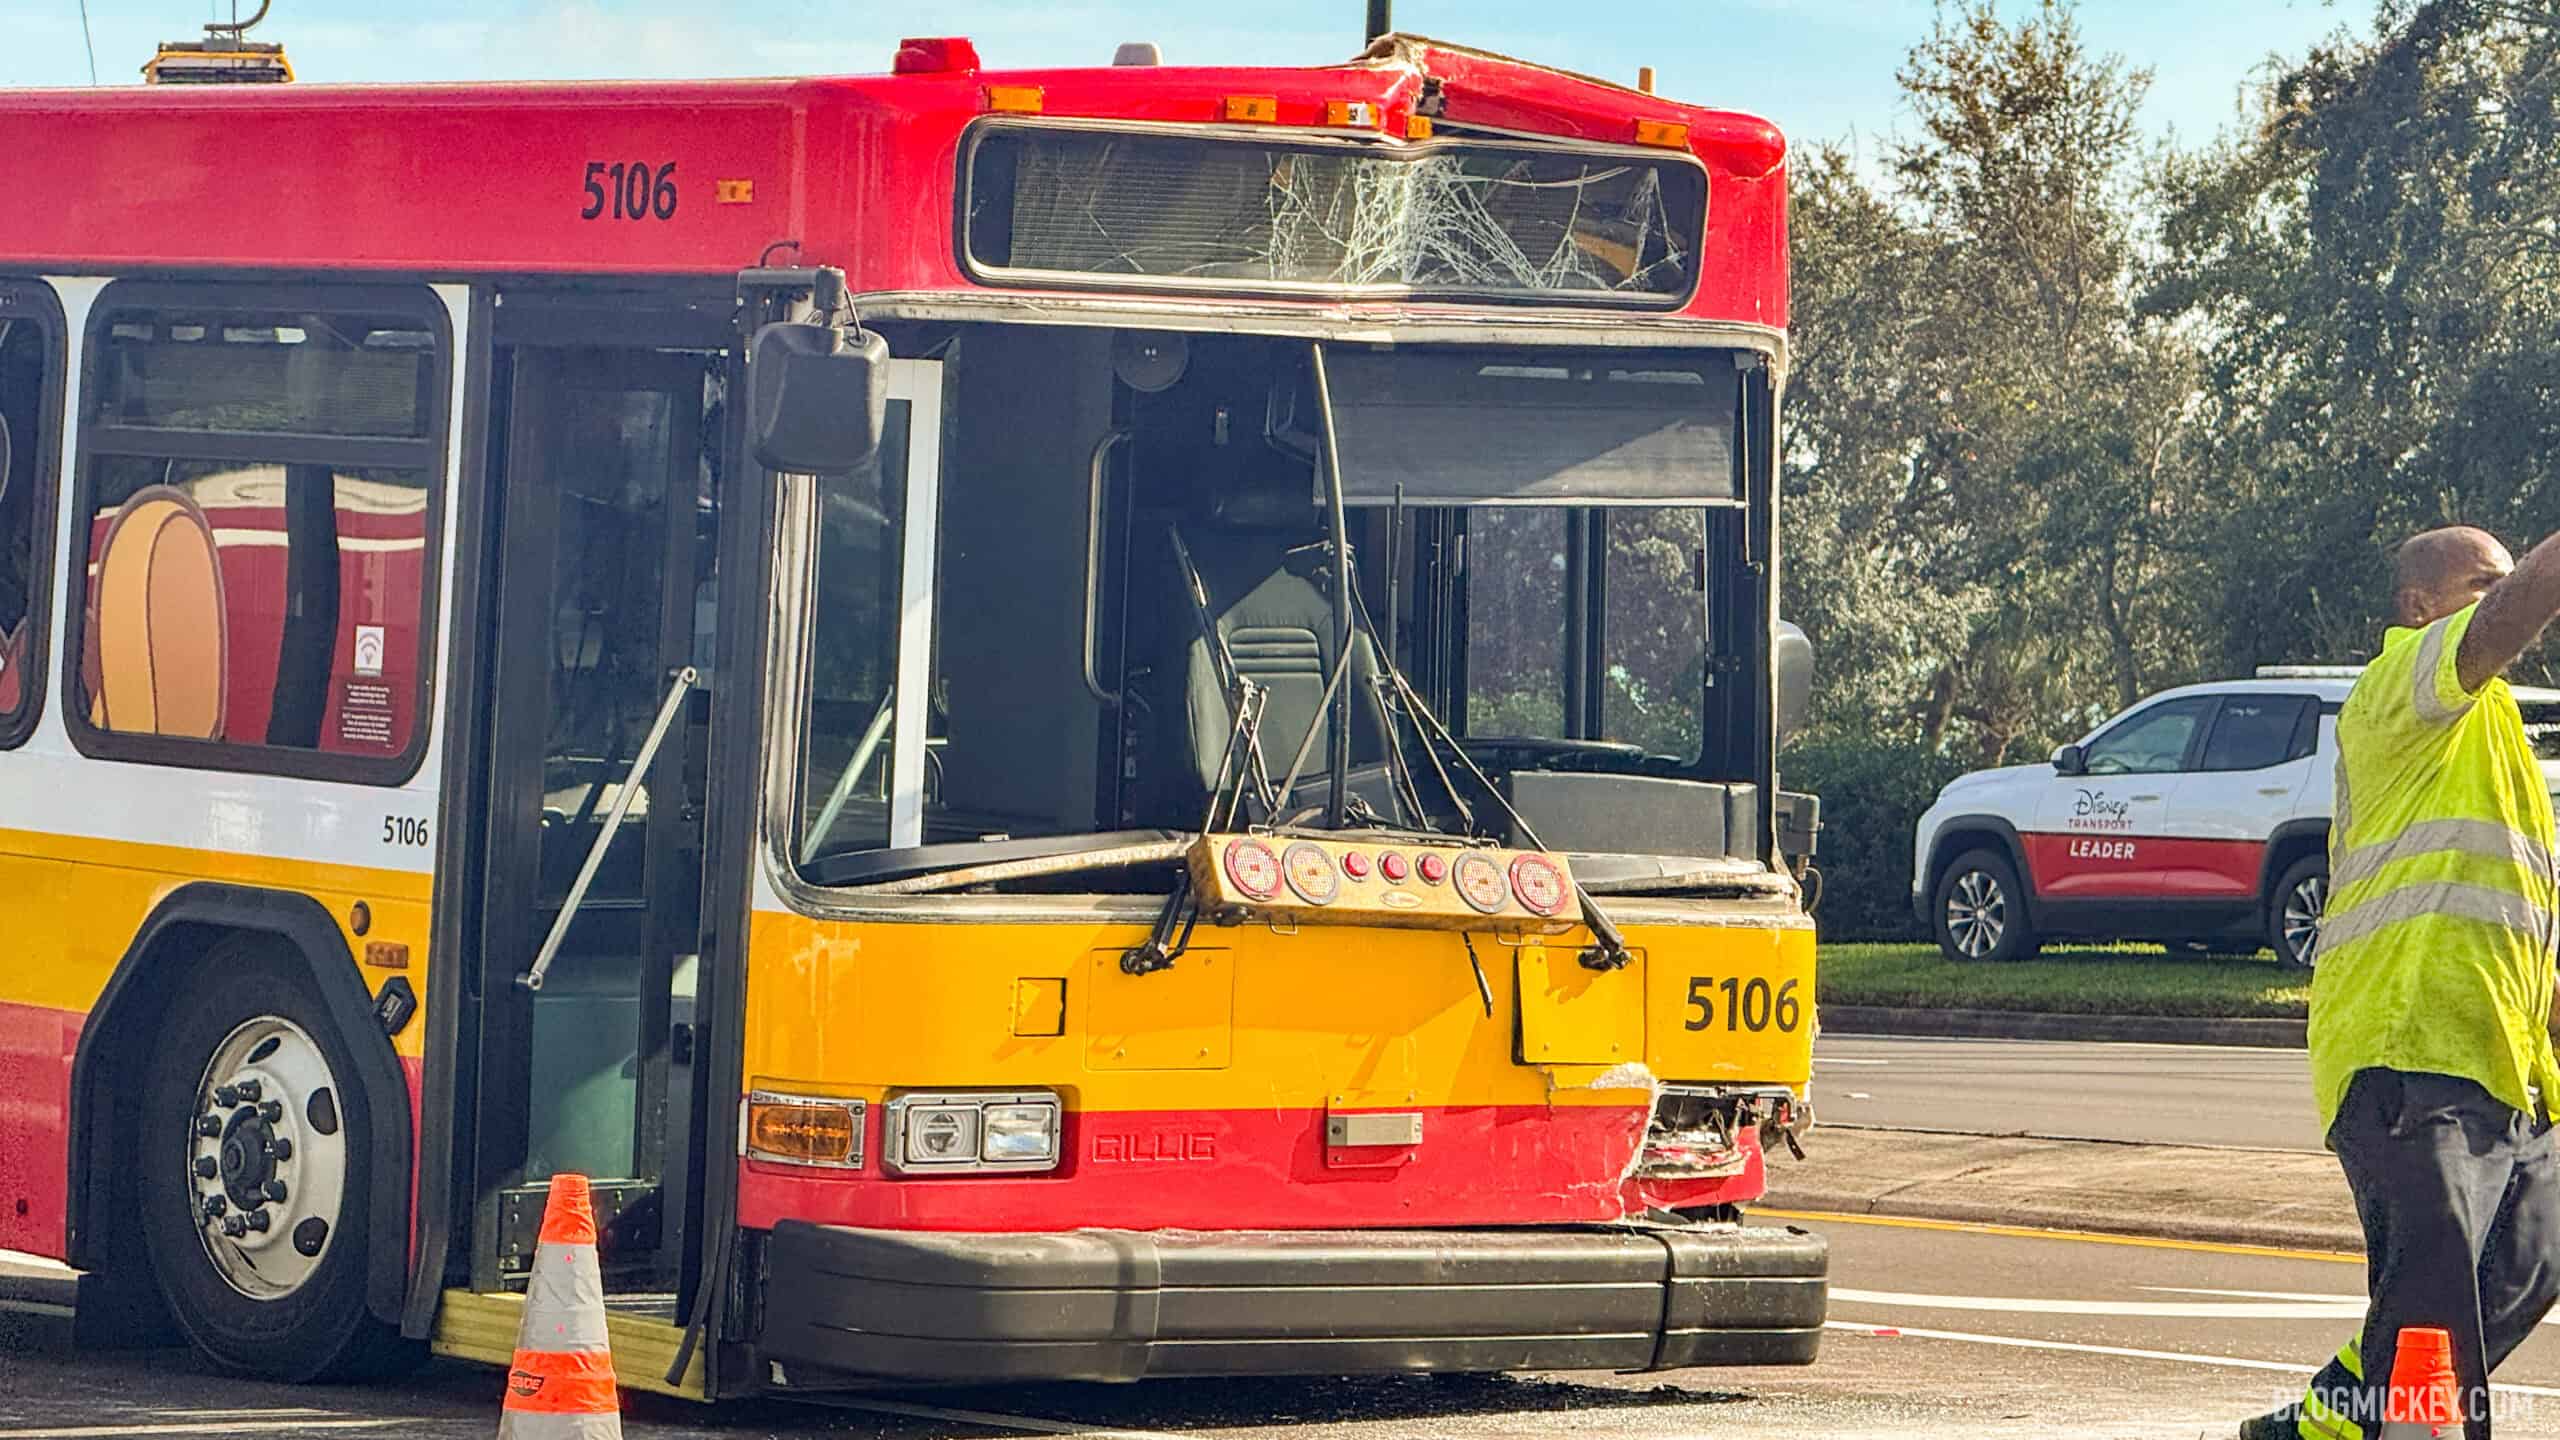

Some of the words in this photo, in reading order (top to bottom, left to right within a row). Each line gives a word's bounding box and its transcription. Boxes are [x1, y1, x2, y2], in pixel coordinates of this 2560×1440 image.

[582, 161, 677, 220] 5106
[2072, 788, 2129, 821] Disney
[383, 815, 428, 847] 5106
[2068, 818, 2134, 830] TRANSPORT
[2069, 839, 2136, 860] LEADER
[1684, 975, 1800, 1033] 5106
[1092, 1133, 1216, 1163] GILLIG
